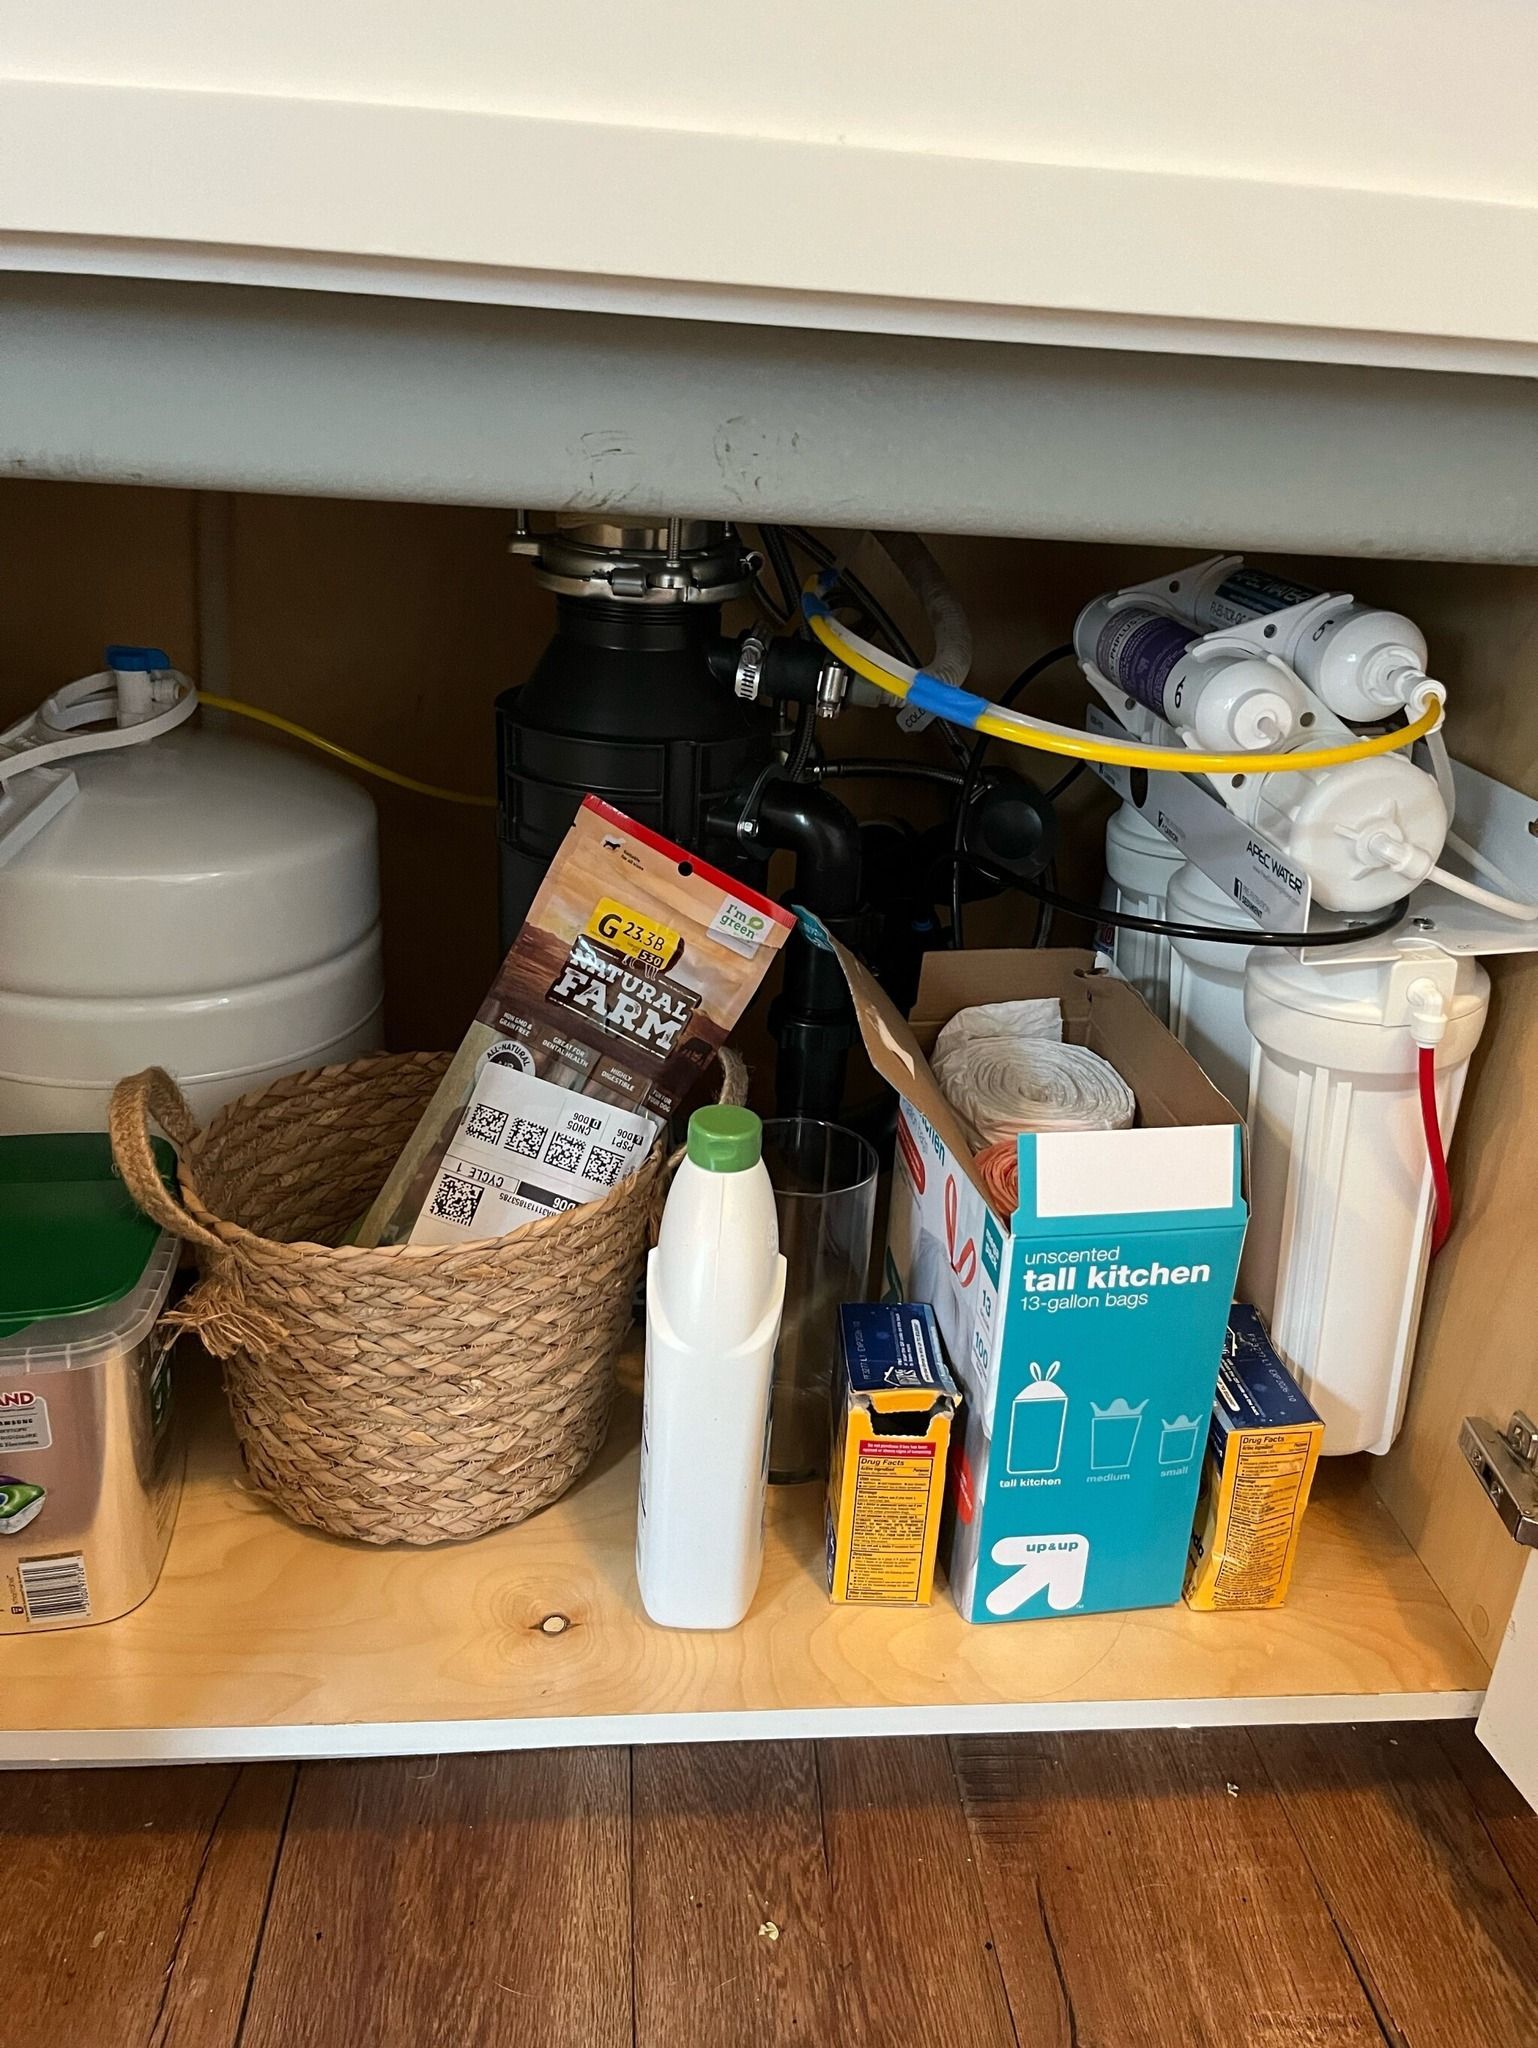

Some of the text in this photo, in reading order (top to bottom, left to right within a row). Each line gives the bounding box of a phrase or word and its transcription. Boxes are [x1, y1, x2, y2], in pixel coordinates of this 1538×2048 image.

[1246, 840, 1271, 870] APEC
[1272, 858, 1303, 896] WATER
[726, 904, 747, 923] I'm
[598, 913, 623, 939] G
[622, 921, 665, 952] 23.3B
[720, 914, 756, 939] green
[570, 949, 688, 1022] NATURAL
[553, 966, 682, 1051] FARM
[486, 1043, 531, 1067] ALL-NATURAL
[542, 1039, 589, 1068] DENTAL HEALTH
[552, 1036, 586, 1058] GREAT FOR
[601, 1070, 635, 1092] DIGESTIBLE
[610, 1067, 632, 1082] HIGHLY
[567, 1120, 592, 1136] CN05
[612, 1137, 634, 1152] PSP1
[456, 1162, 505, 1187] CYCLE 1
[1025, 1246, 1120, 1265] unscented
[1023, 1262, 1211, 1292] tall kitchen
[982, 1289, 991, 1318] 13
[1020, 1292, 1149, 1313] 13-gallon bags
[975, 1331, 988, 1369] 100
[1242, 1437, 1262, 1445] Drug
[860, 1458, 880, 1466] Drug
[1160, 1466, 1189, 1477] small
[1000, 1477, 1062, 1488] tall kitchen
[1086, 1472, 1130, 1483] medium
[1026, 1541, 1079, 1554] up&up
